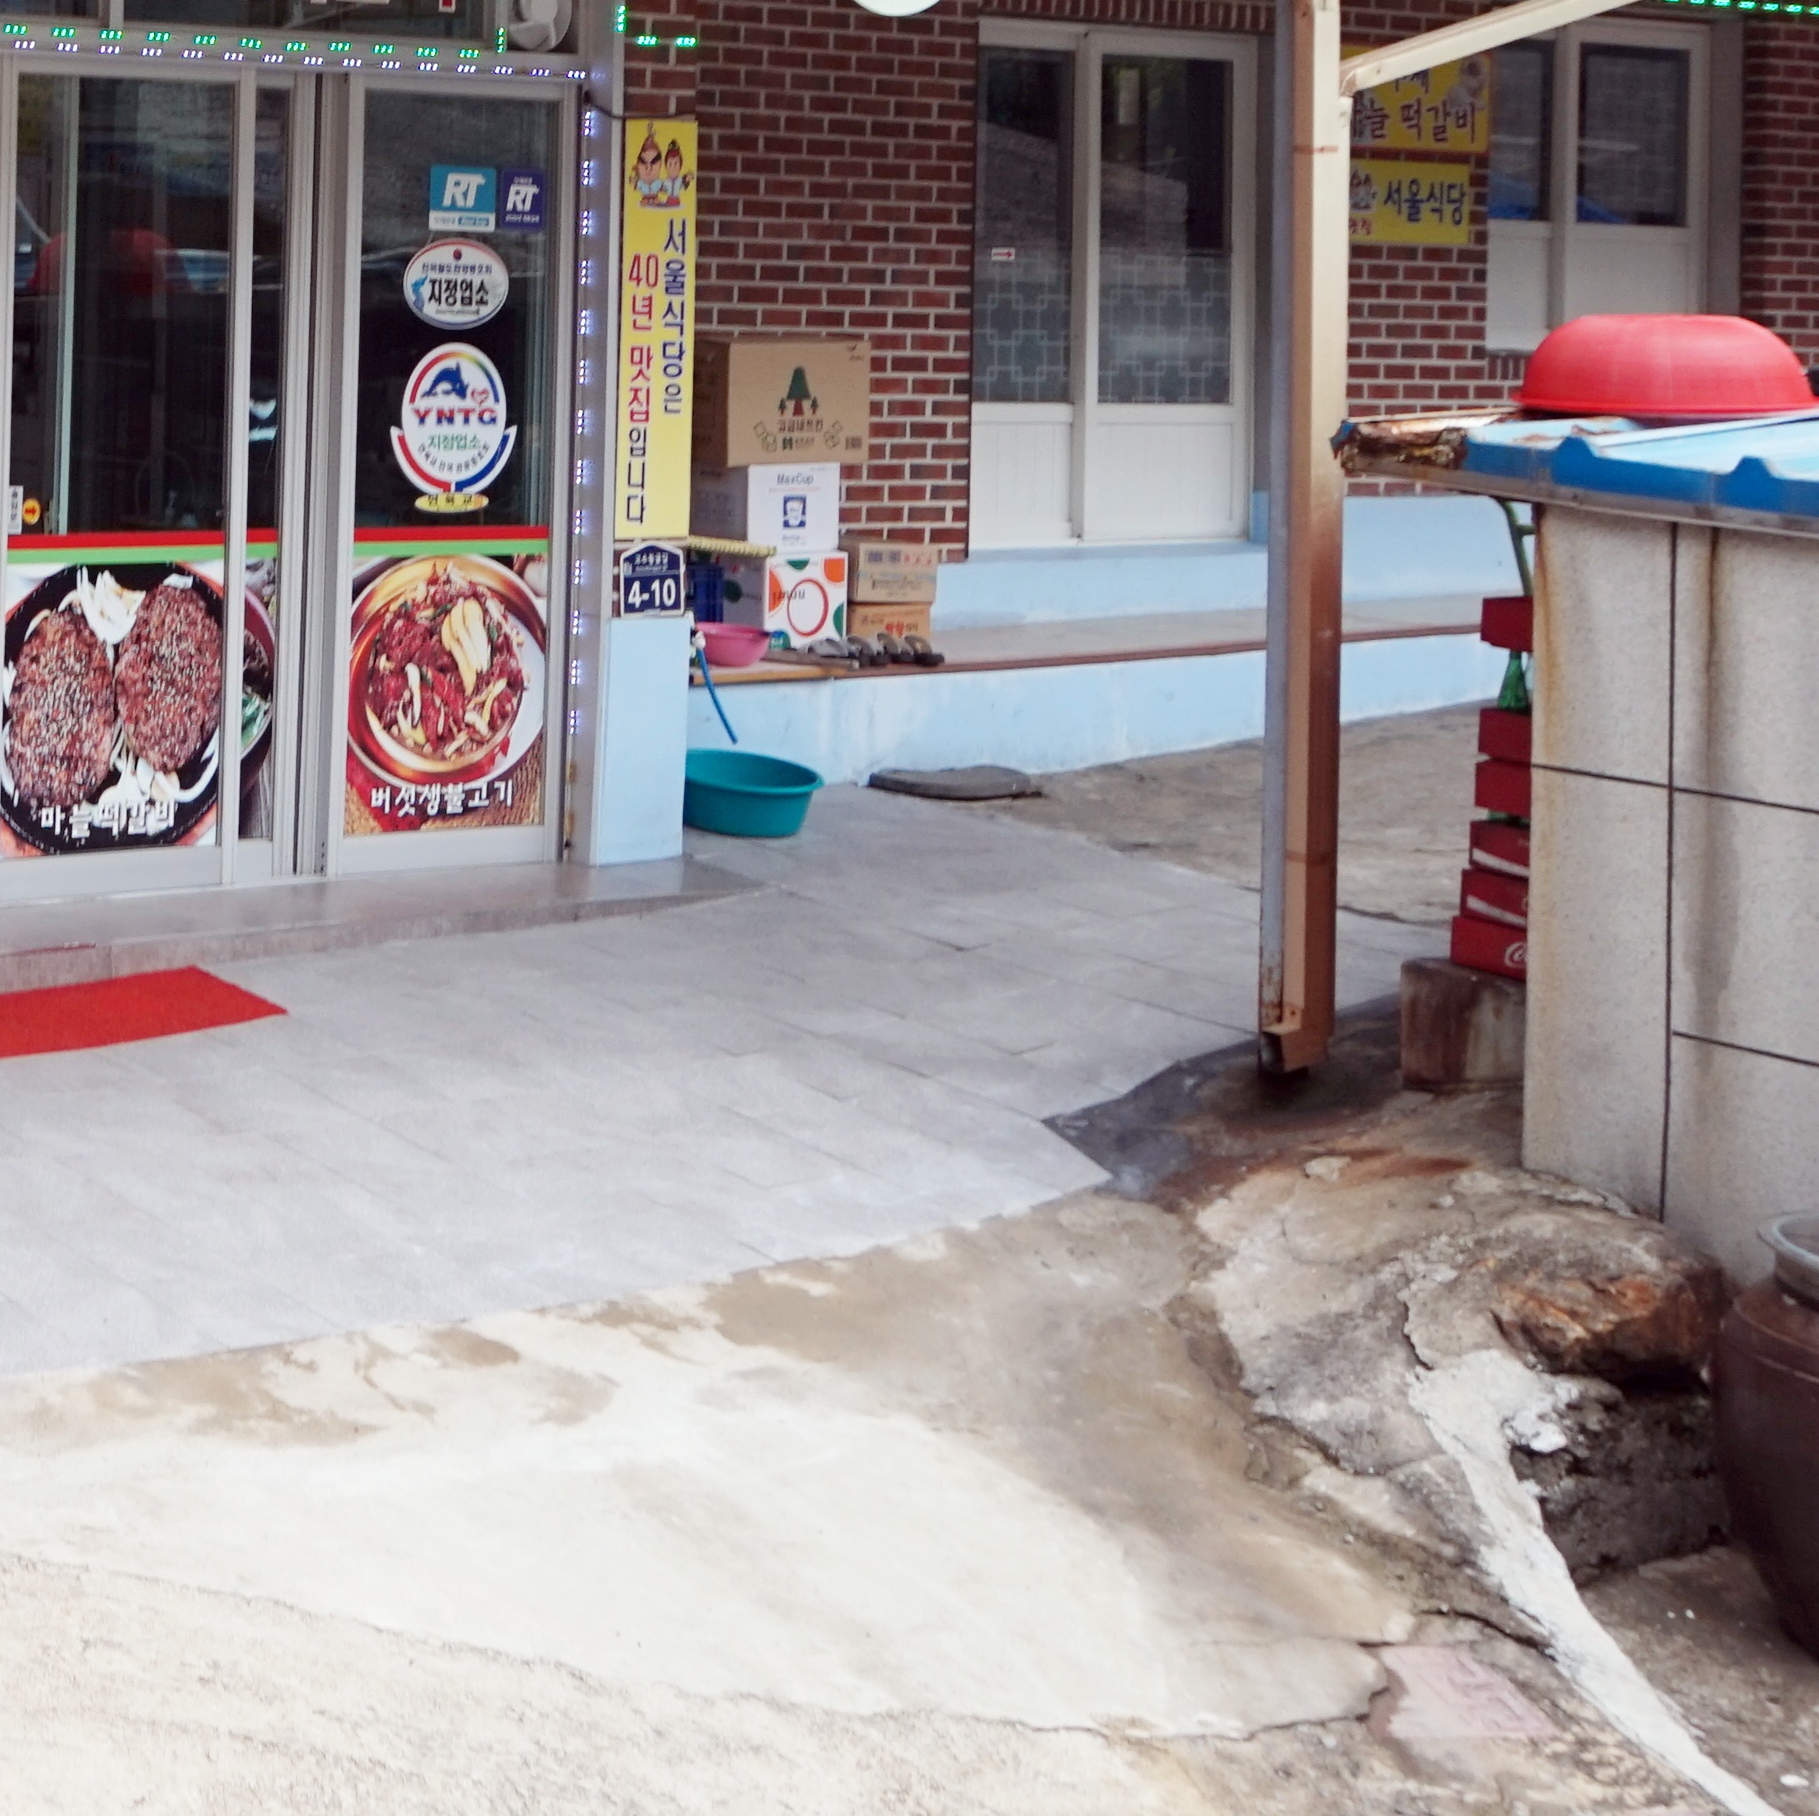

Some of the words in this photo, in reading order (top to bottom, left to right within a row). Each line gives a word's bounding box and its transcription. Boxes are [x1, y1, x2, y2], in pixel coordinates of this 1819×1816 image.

[1401, 97, 1476, 144] 떡갈비
[442, 172, 486, 208] RT
[506, 184, 539, 212] RT
[1384, 178, 1466, 226] 서울식당
[428, 278, 489, 306] 지정업소
[628, 253, 660, 332] 40년
[662, 218, 688, 415] 서울식당은
[413, 407, 498, 425] YNTG
[625, 343, 654, 526] 맛집입니다
[628, 578, 676, 608] 4-10
[39, 798, 178, 839] 마늘떡갈비
[370, 781, 514, 819] 버섯생불고기
